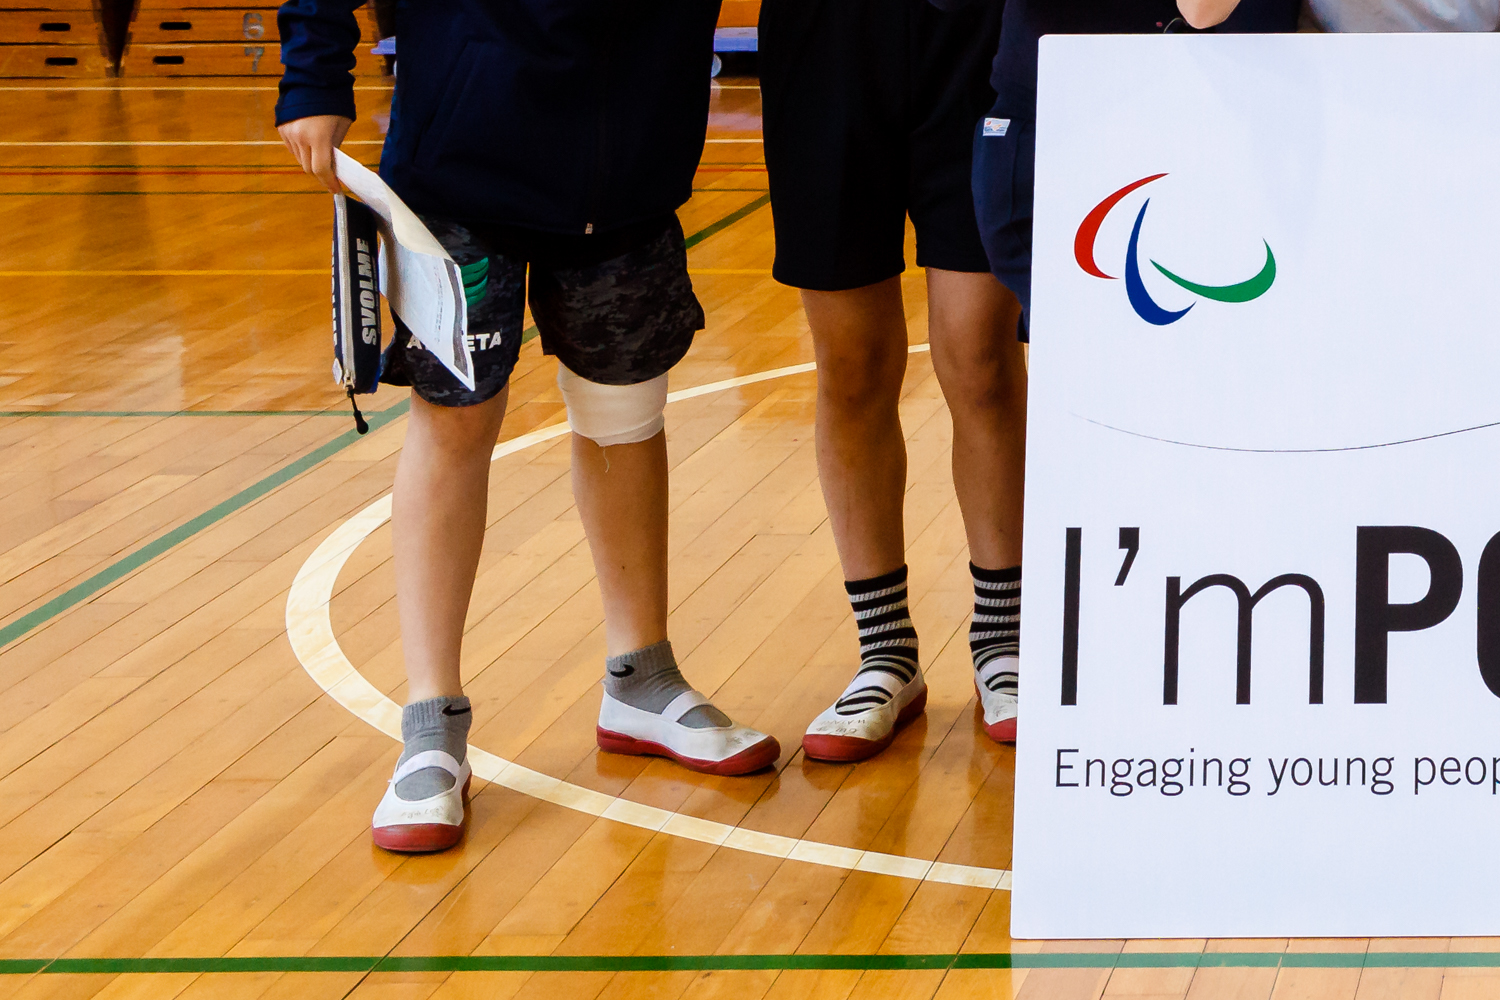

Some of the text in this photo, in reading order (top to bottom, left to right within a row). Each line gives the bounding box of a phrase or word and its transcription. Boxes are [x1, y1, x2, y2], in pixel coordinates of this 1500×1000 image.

[242, 12, 265, 40] 6
[244, 46, 265, 73] 7
[356, 238, 377, 346] SVOLME
[406, 331, 502, 352] AETA
[1055, 747, 1252, 797] Engaging
[1267, 756, 1395, 796] young
